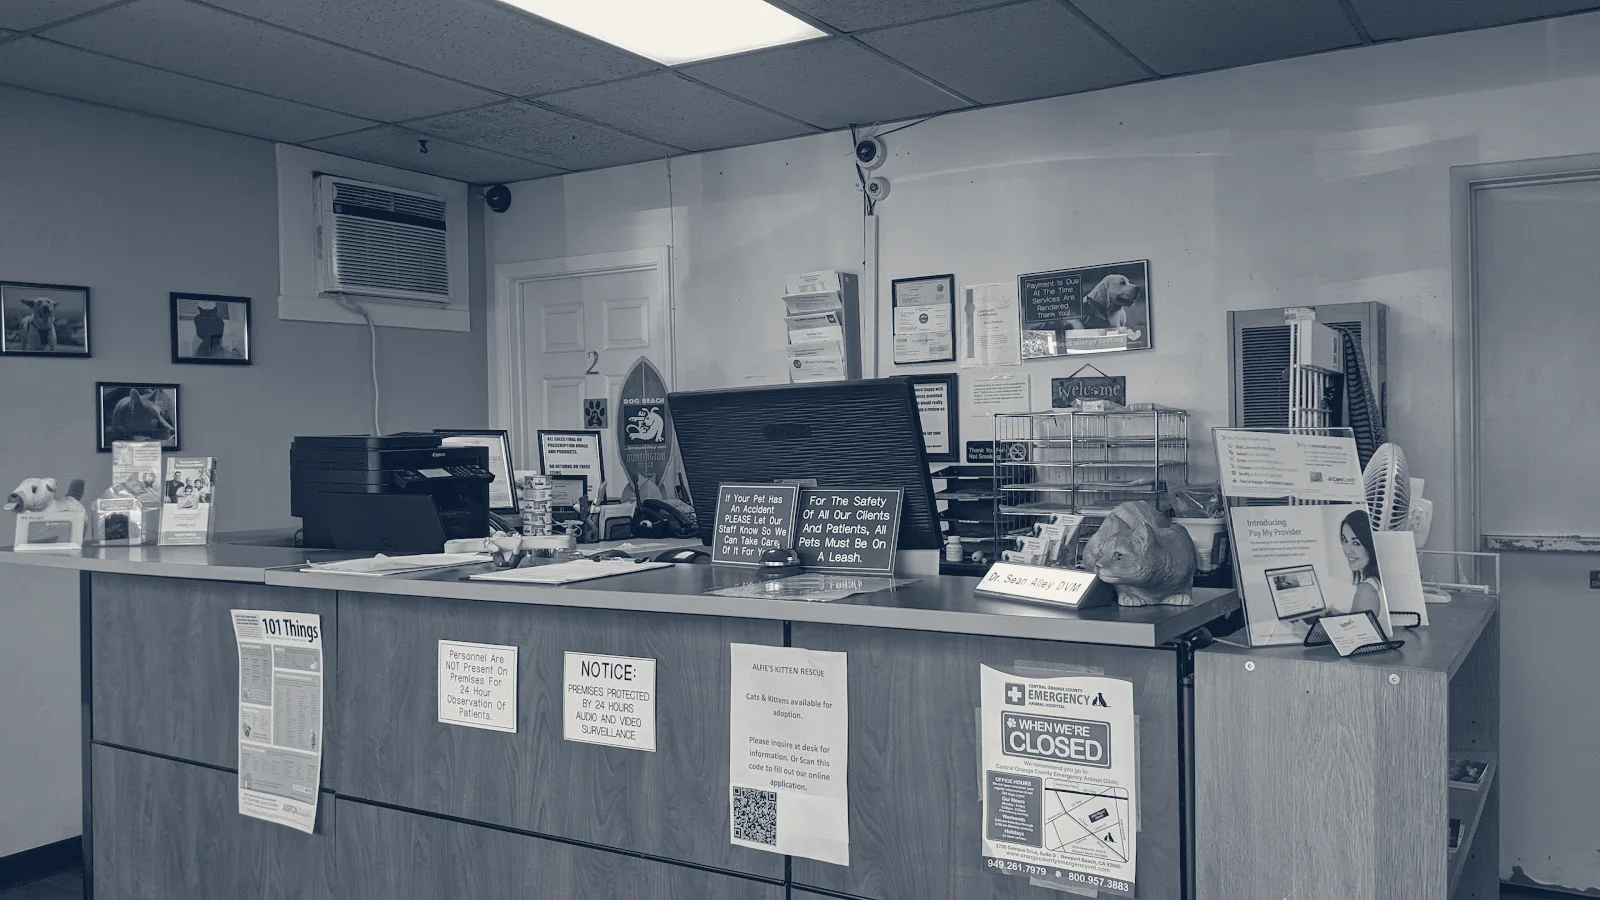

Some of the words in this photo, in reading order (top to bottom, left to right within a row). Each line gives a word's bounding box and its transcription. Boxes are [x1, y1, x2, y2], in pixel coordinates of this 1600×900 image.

[1026, 280, 1054, 290] Payment
[1032, 296, 1060, 304] Services
[1037, 303, 1070, 311] Rendered.
[586, 350, 599, 374] 2
[592, 413, 598, 422] 2
[626, 452, 666, 462] HUNTINGTON
[725, 494, 731, 502] If
[734, 494, 749, 503] Your
[753, 495, 766, 503] Pet
[768, 495, 783, 503] Has
[809, 496, 826, 505] For
[831, 496, 848, 506] The
[853, 496, 887, 508] Safety
[731, 505, 740, 513] An
[743, 505, 774, 514] Accident
[803, 510, 814, 519] Of
[818, 510, 829, 519] All
[834, 511, 852, 520] Our
[856, 510, 890, 520] Clients
[725, 516, 751, 524] PLEASE
[754, 516, 765, 524] Let
[770, 517, 782, 526] Our
[1247, 519, 1287, 527] Introducing
[719, 525, 736, 534] Staff
[740, 526, 758, 535] Know
[762, 527, 771, 535] So
[775, 528, 786, 536] We
[1249, 530, 1261, 538] Pay
[1262, 529, 1273, 537] My
[1274, 528, 1302, 536] Provider
[817, 552, 824, 562] A
[829, 552, 862, 563] Leash.
[989, 572, 999, 582] Dr.
[1004, 574, 1027, 586] Sean
[1030, 577, 1055, 590] Alley
[1056, 581, 1081, 593] DVM
[262, 618, 281, 635] 101
[283, 618, 318, 642] Things
[450, 650, 486, 662] Personnel
[491, 654, 504, 663] Are
[446, 661, 459, 670] NOT
[464, 663, 493, 674] Present
[498, 666, 507, 675] On
[581, 661, 636, 681] NOTICE:
[752, 664, 774, 672] ALFIE'S
[775, 666, 799, 675] KITTEN
[801, 668, 825, 677] RESCUE
[451, 673, 484, 684] Premises
[489, 677, 502, 686] For
[460, 685, 469, 694] 24
[474, 687, 491, 697] Hour
[568, 684, 603, 696] PREMISES
[607, 688, 649, 701] PROTECTED
[1028, 689, 1090, 705] EMERGENCY
[583, 699, 592, 708] BY
[595, 700, 605, 709] 24
[609, 702, 634, 713] HOURS
[768, 695, 789, 705] Kittens
[790, 698, 821, 708] available
[773, 709, 803, 719] adoption.
[582, 725, 636, 740] SURVEILLANCE
[1019, 719, 1052, 732] WHEN
[1054, 723, 1090, 737] WE'RE
[749, 736, 770, 745] Please
[771, 739, 793, 749] inquire
[802, 744, 818, 752] desk
[820, 745, 830, 753] for
[1010, 731, 1103, 760] CLOSED
[750, 749, 789, 761] information.
[800, 756, 815, 766] Scan
[817, 759, 830, 767] this
[1015, 766, 1033, 774] Orange
[1054, 772, 1082, 781] Emergency
[1033, 763, 1063, 771] recommend
[1002, 814, 1025, 822] Weekends
[1006, 851, 1110, 873] www.orangecountyemergencyvet.com
[1061, 854, 1080, 862] Newport
[1081, 856, 1098, 864] Beach,
[987, 859, 1047, 875] 949.261.7979
[1069, 873, 1129, 892] 800.957.3883
